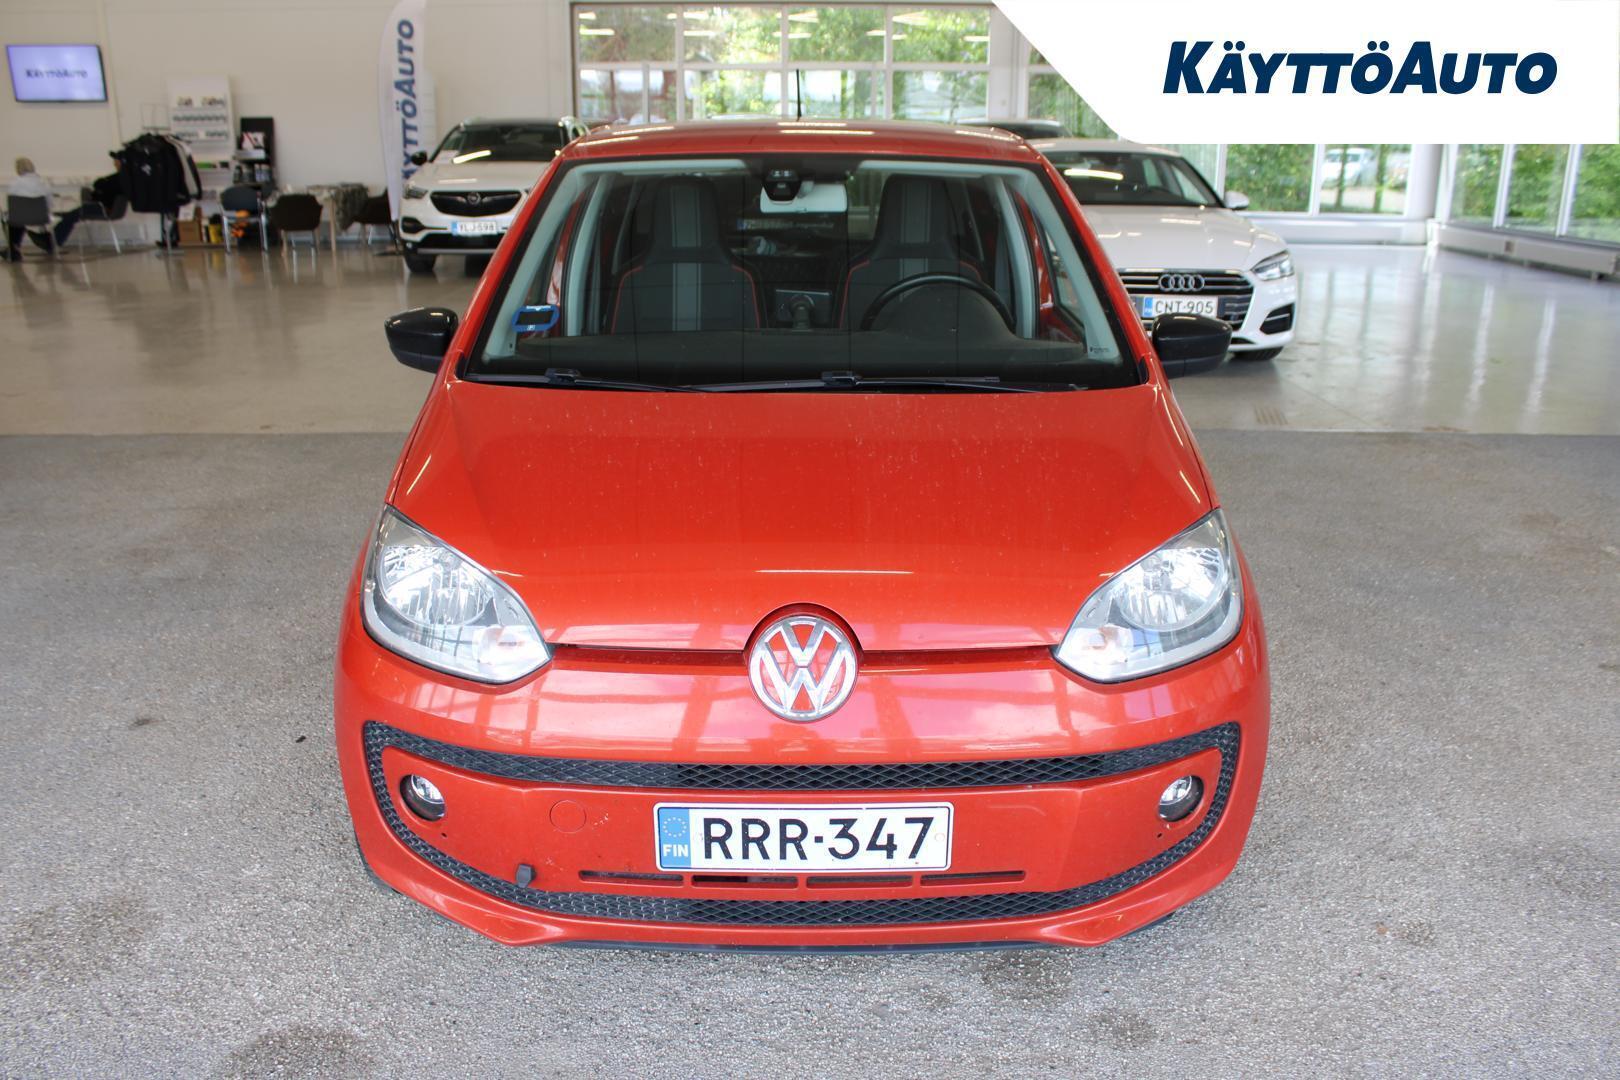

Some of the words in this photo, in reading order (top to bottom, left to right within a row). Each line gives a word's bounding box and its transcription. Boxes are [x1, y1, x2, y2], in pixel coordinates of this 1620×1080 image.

[1155, 301, 1213, 313] CNT-905
[703, 816, 934, 860] RRR-347
[663, 844, 689, 858] FIN
